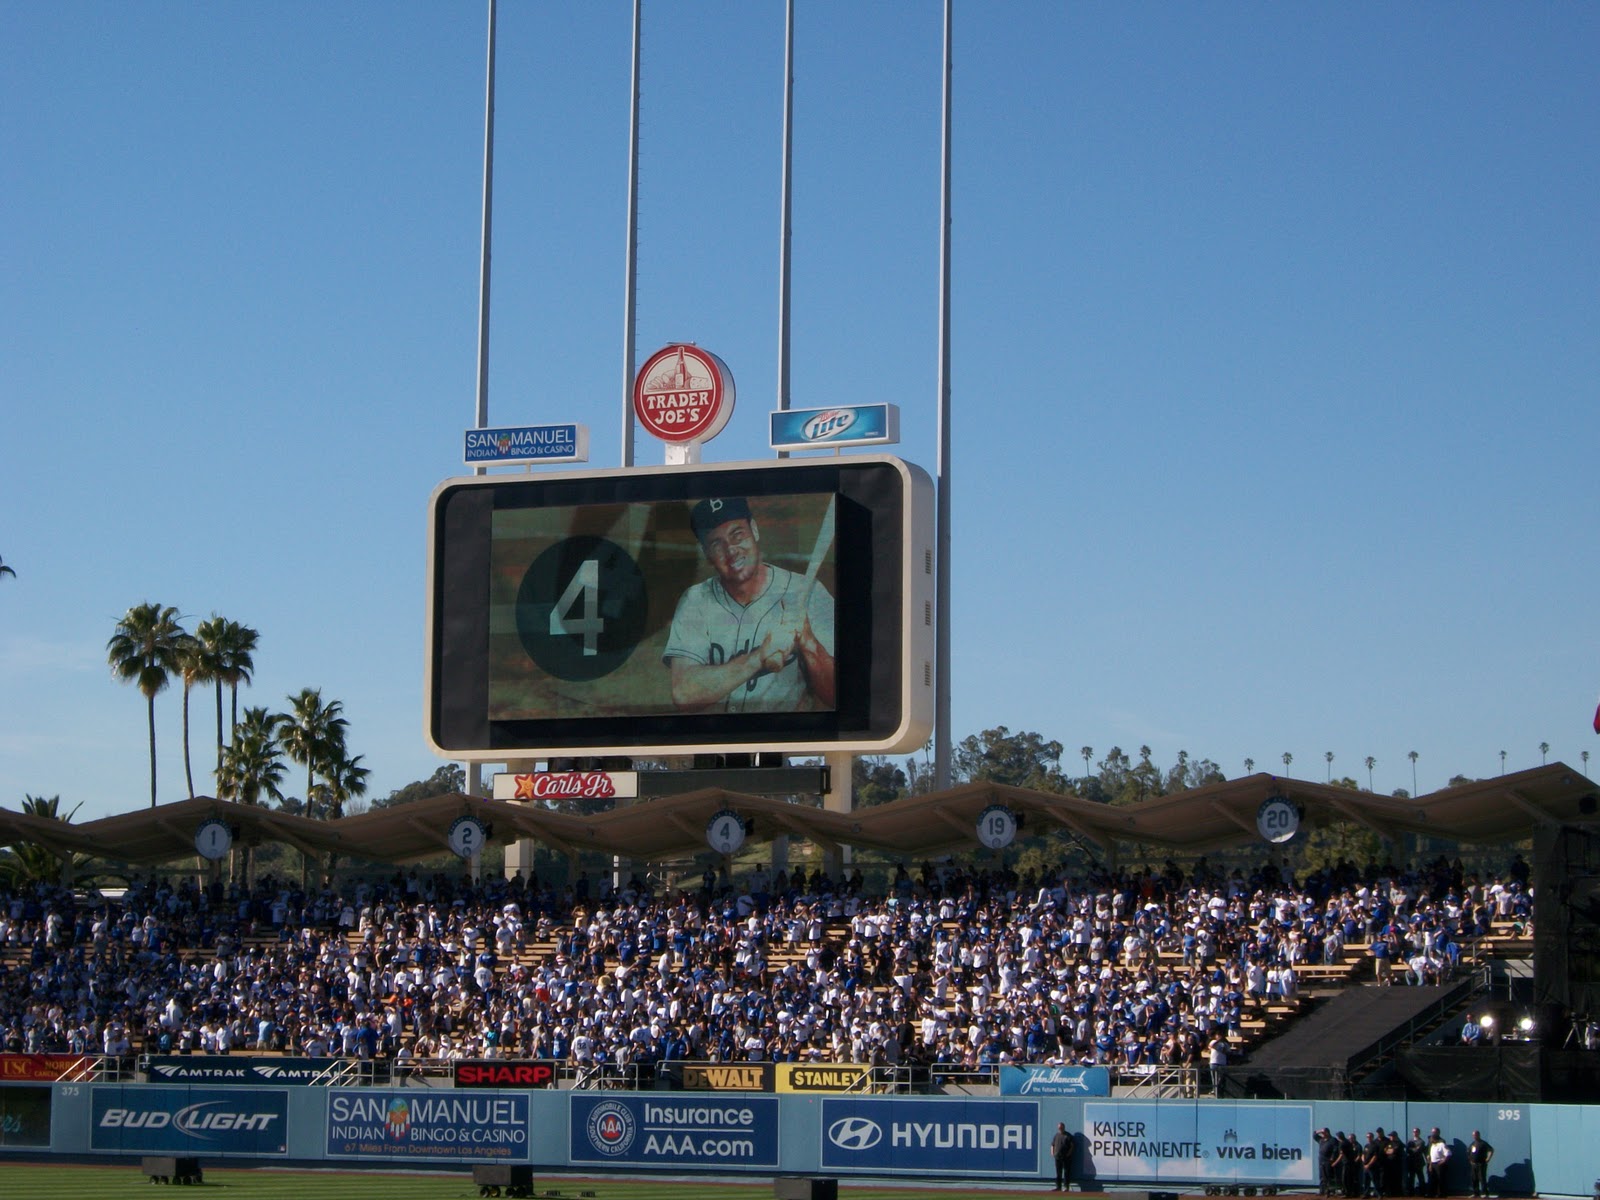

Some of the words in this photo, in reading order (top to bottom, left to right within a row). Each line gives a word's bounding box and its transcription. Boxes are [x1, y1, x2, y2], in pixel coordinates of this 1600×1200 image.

[646, 392, 710, 410] TRADER
[654, 408, 700, 425] JOE'S
[810, 414, 850, 440] Lite
[467, 433, 498, 448] SAN
[511, 430, 574, 446] MANUEL
[467, 448, 498, 458] INDIAN
[510, 446, 536, 456] BINGO
[537, 446, 544, 456] &
[544, 444, 574, 454] CASINO
[550, 560, 604, 656] 4
[534, 776, 582, 797] Carl's
[583, 774, 613, 796] Jr.
[988, 817, 1005, 836] 19
[1267, 810, 1288, 828] 20
[211, 830, 216, 846] 1
[462, 827, 472, 844] 2
[720, 822, 730, 840] 4
[3, 1058, 32, 1074] USC
[178, 1069, 246, 1078] AMTRAK
[278, 1070, 343, 1079] AMTRAK
[458, 1066, 552, 1084] SHARP
[794, 1071, 862, 1086] STANLEY
[1020, 1068, 1049, 1094] John
[1048, 1068, 1088, 1090] Hancock
[62, 1086, 80, 1096] 375
[100, 1108, 169, 1128] BUD
[186, 1109, 278, 1131] LIGHT
[332, 1097, 386, 1122] SAN
[412, 1098, 525, 1125] MANUEL
[590, 1102, 621, 1122] AUTOMOBILE
[620, 1108, 632, 1124] CLUB
[644, 1103, 754, 1126] Insurance
[1498, 1110, 1520, 1121] 395
[332, 1125, 386, 1140] INDIAN
[410, 1127, 456, 1142] BINGO
[459, 1128, 470, 1143] &
[472, 1128, 526, 1144] CASINO
[600, 1120, 622, 1134] AAA
[892, 1122, 1032, 1150] HYUNDAI
[1093, 1120, 1146, 1138] KAISER
[589, 1125, 610, 1153] SOUTHERN
[610, 1126, 634, 1153] CALIFORNIA
[644, 1134, 754, 1156] AAA.com
[360, 1144, 382, 1153] Miles
[384, 1144, 407, 1154] From
[408, 1144, 457, 1154] Downtown
[458, 1146, 472, 1155] Los
[473, 1146, 512, 1158] Angeles
[1093, 1140, 1202, 1158] PERMANENTE
[1216, 1144, 1256, 1160] viva
[1262, 1143, 1302, 1160] bien
